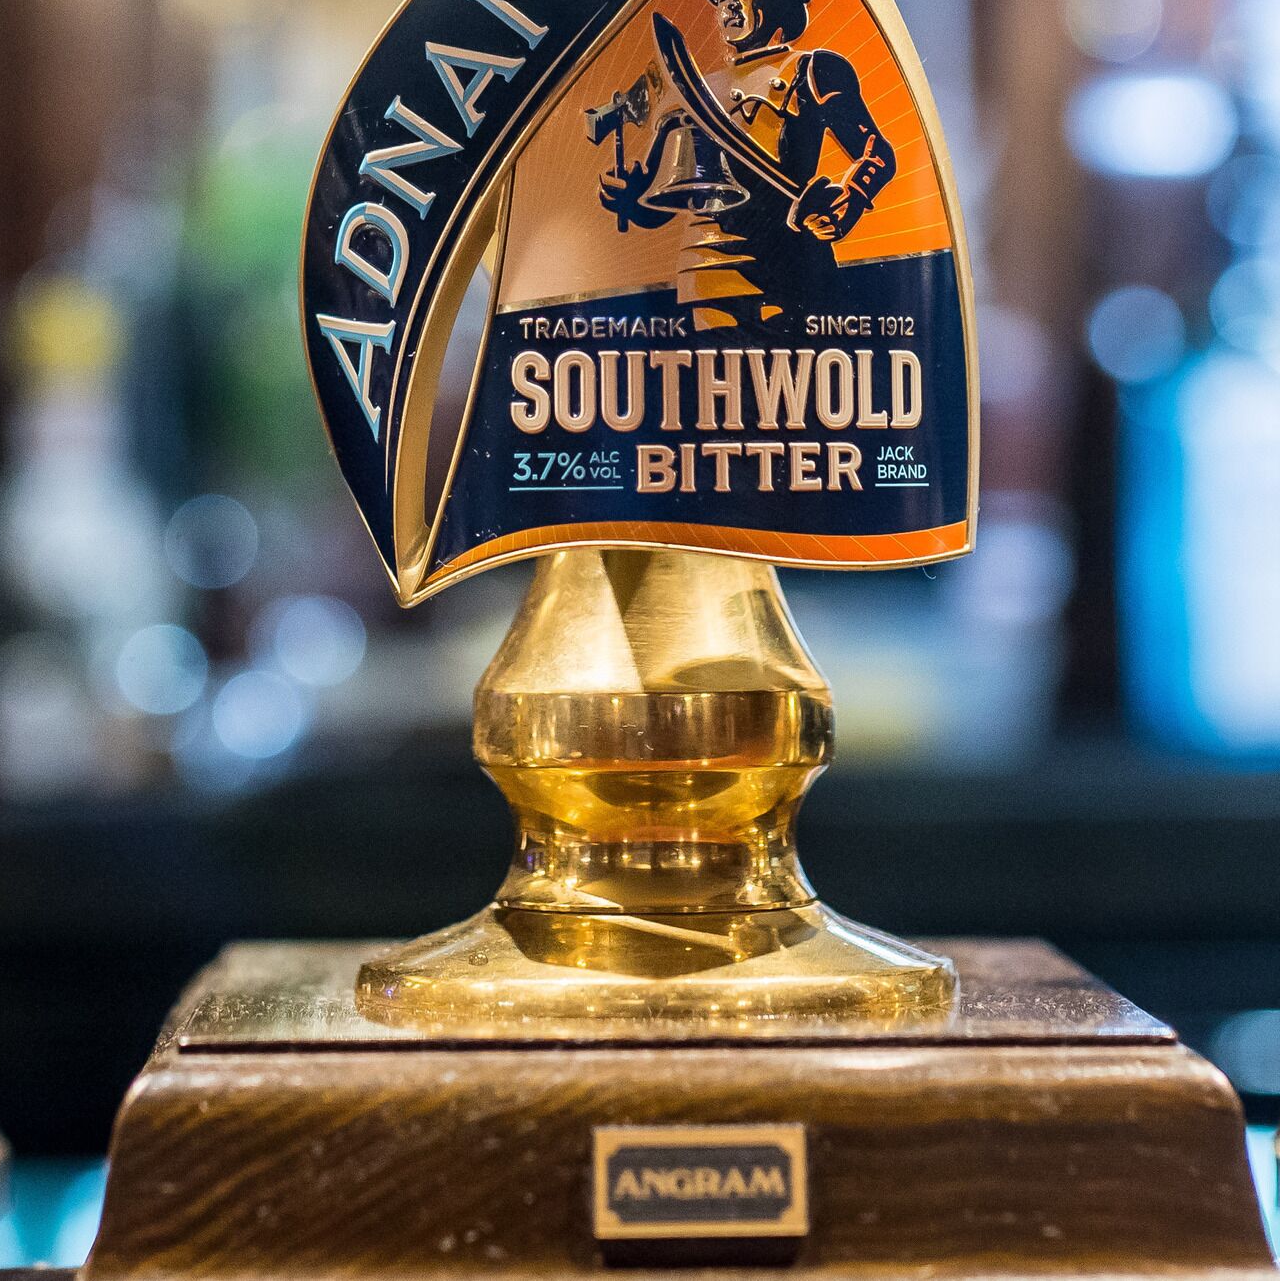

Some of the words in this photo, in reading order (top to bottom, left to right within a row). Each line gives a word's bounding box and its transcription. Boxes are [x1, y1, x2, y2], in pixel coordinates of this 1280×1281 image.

[519, 316, 688, 340] TRADEMARK
[805, 314, 872, 336] SINCE
[877, 316, 915, 337] 1912
[510, 348, 923, 434] SOUTHWOLD
[589, 450, 621, 464] ALC
[876, 445, 915, 462] JACK
[513, 451, 587, 481] 3.7%
[589, 466, 622, 480] VOL
[635, 442, 865, 494] BITTER
[877, 463, 928, 480] BRAND
